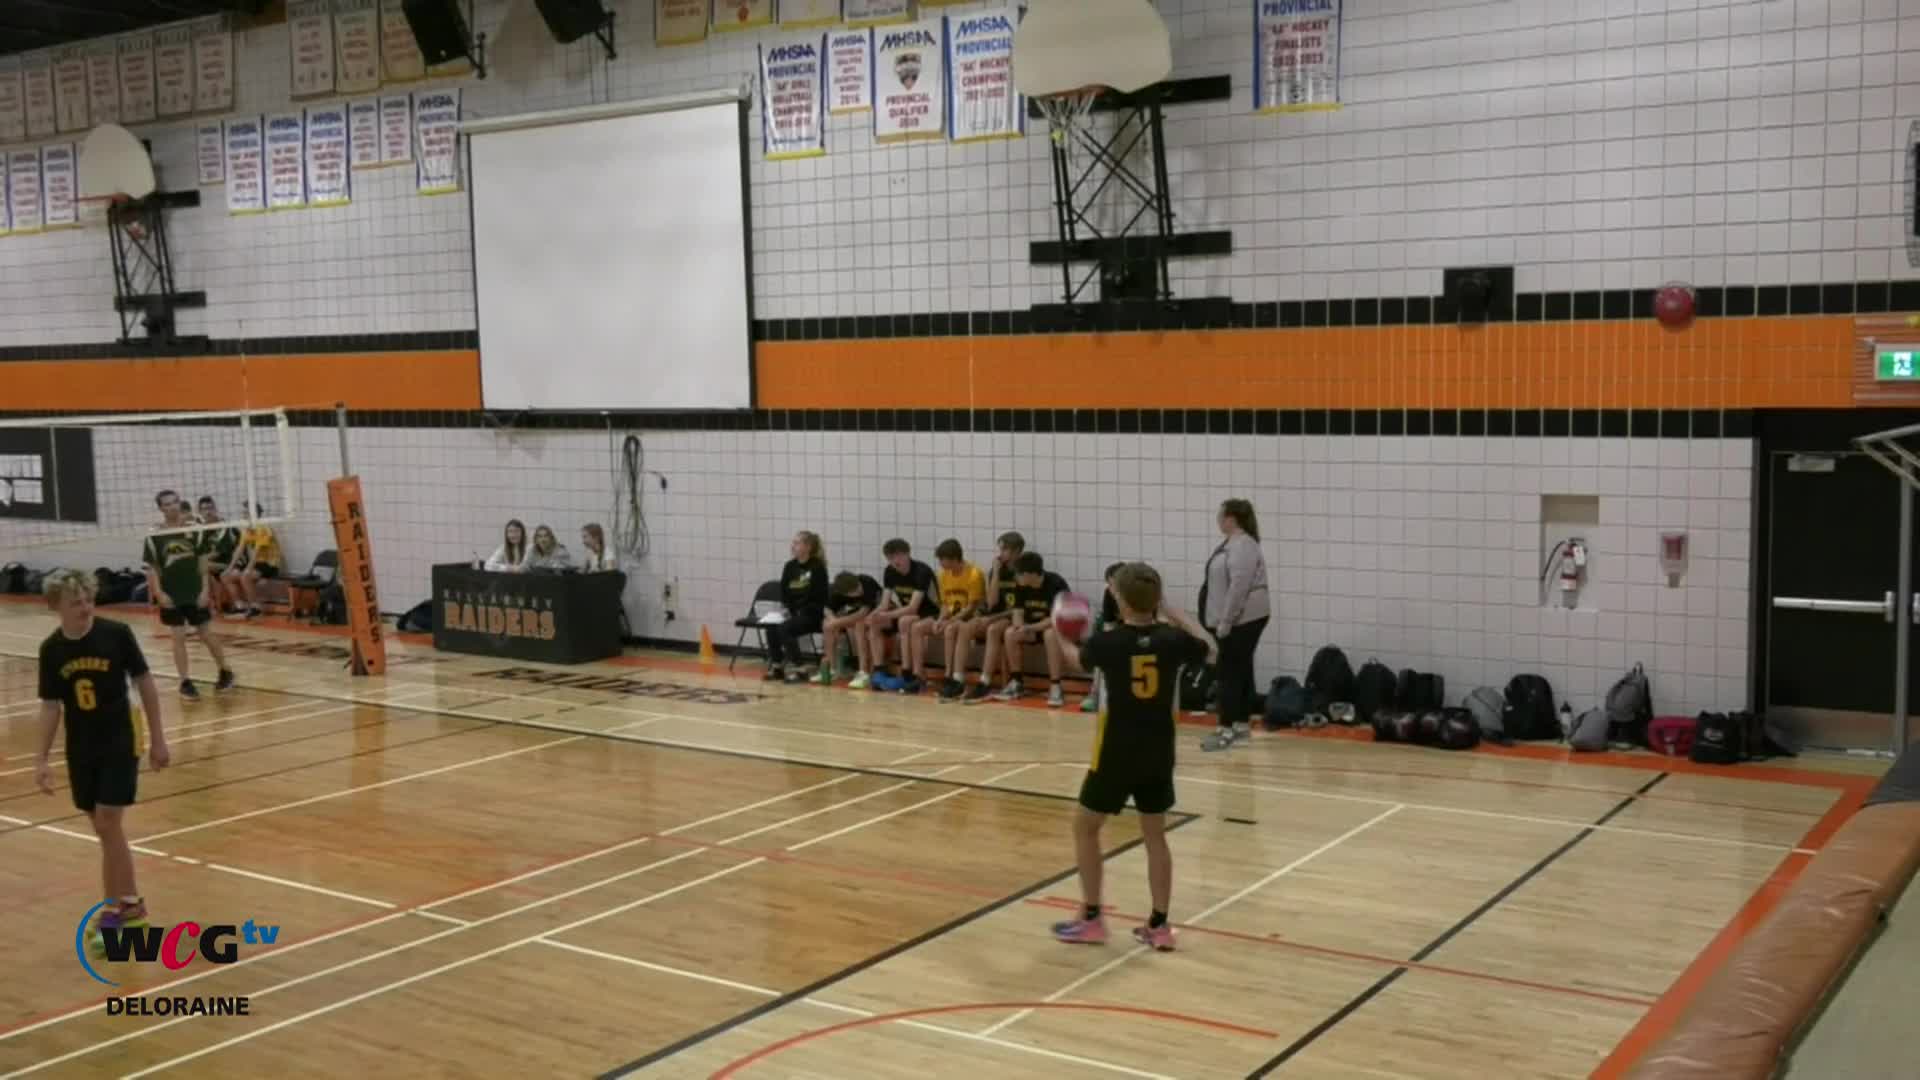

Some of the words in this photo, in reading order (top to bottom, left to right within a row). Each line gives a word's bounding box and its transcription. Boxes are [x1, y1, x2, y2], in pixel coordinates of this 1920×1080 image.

[1263, 0, 1331, 16] PROVINCIAL
[956, 16, 1013, 39] MHSAA
[1292, 20, 1328, 33] HOCKEY
[879, 30, 936, 53] MHSAA
[956, 38, 1012, 55] PROVINCIAL
[767, 44, 816, 63] MHSAA
[768, 62, 816, 78] PROVINCIAL
[979, 57, 1009, 69] HOCKEY
[962, 72, 1008, 87] CHAMPIONS
[886, 93, 930, 106] PROVINCIAL
[347, 502, 382, 644] RAIDERS
[445, 601, 556, 641] RAIDERS
[1130, 654, 1160, 699] 5
[75, 678, 97, 711] 6
